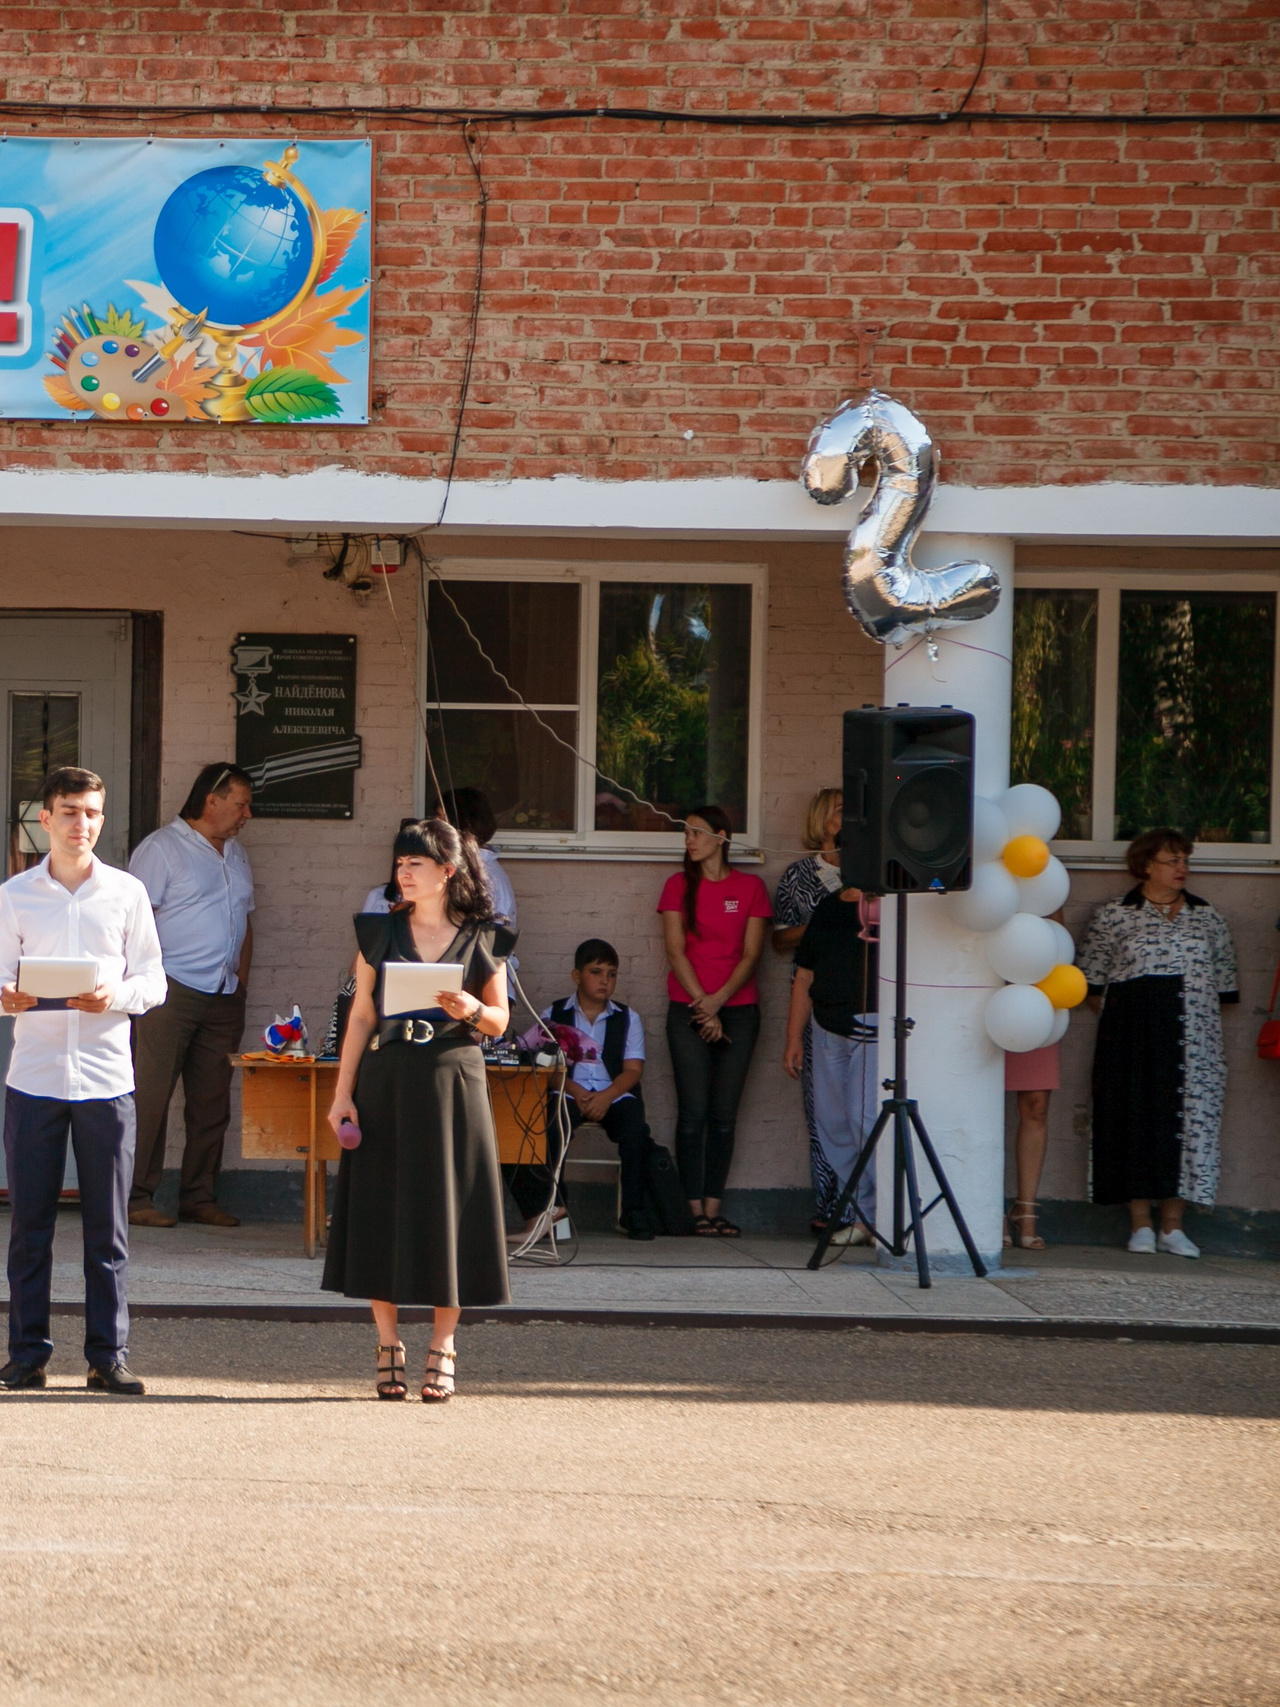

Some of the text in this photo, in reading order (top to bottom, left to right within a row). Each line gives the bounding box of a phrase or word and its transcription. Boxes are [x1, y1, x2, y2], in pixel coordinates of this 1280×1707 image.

[275, 684, 346, 699] НАЙДЁНОВА
[284, 707, 335, 717] НИКОЛАЯ
[272, 725, 346, 735] АЛЕКСЕЕВИЧА
